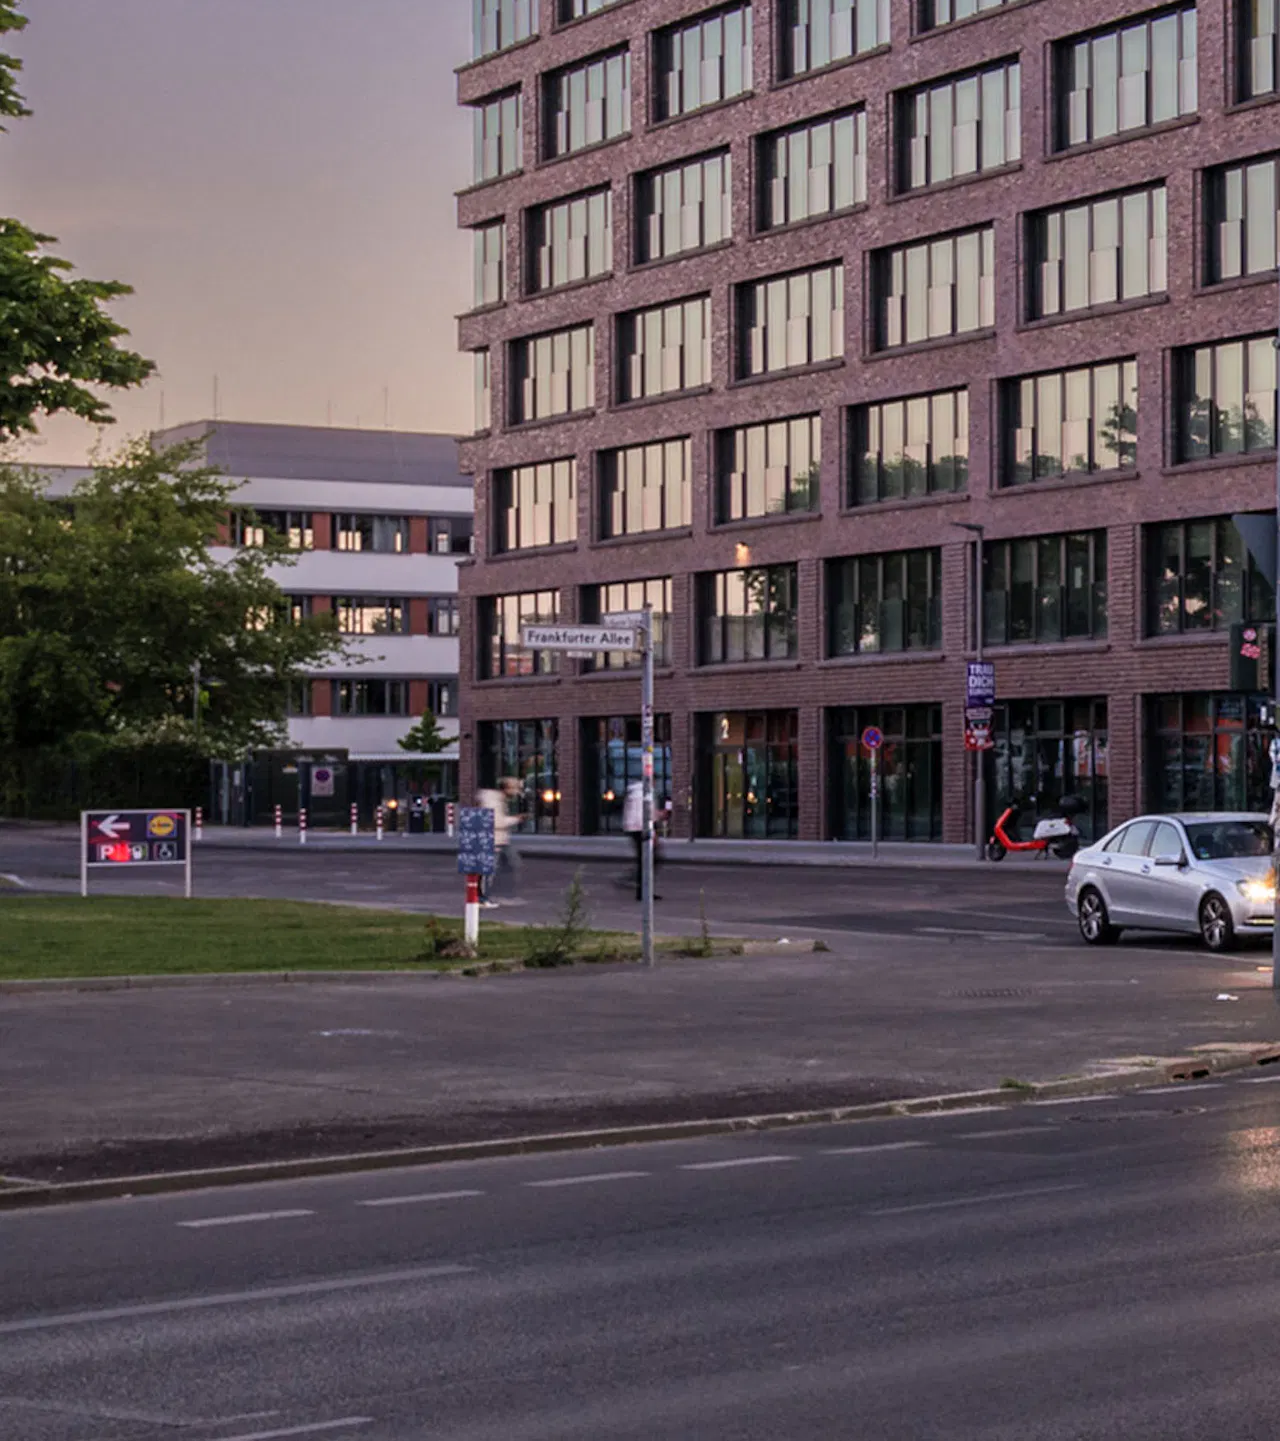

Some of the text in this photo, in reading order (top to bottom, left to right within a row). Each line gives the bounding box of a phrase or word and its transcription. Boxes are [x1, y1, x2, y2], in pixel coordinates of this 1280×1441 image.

[528, 630, 631, 645] Frankfurter Allee
[968, 675, 994, 688] DICH
[101, 844, 115, 860] P
